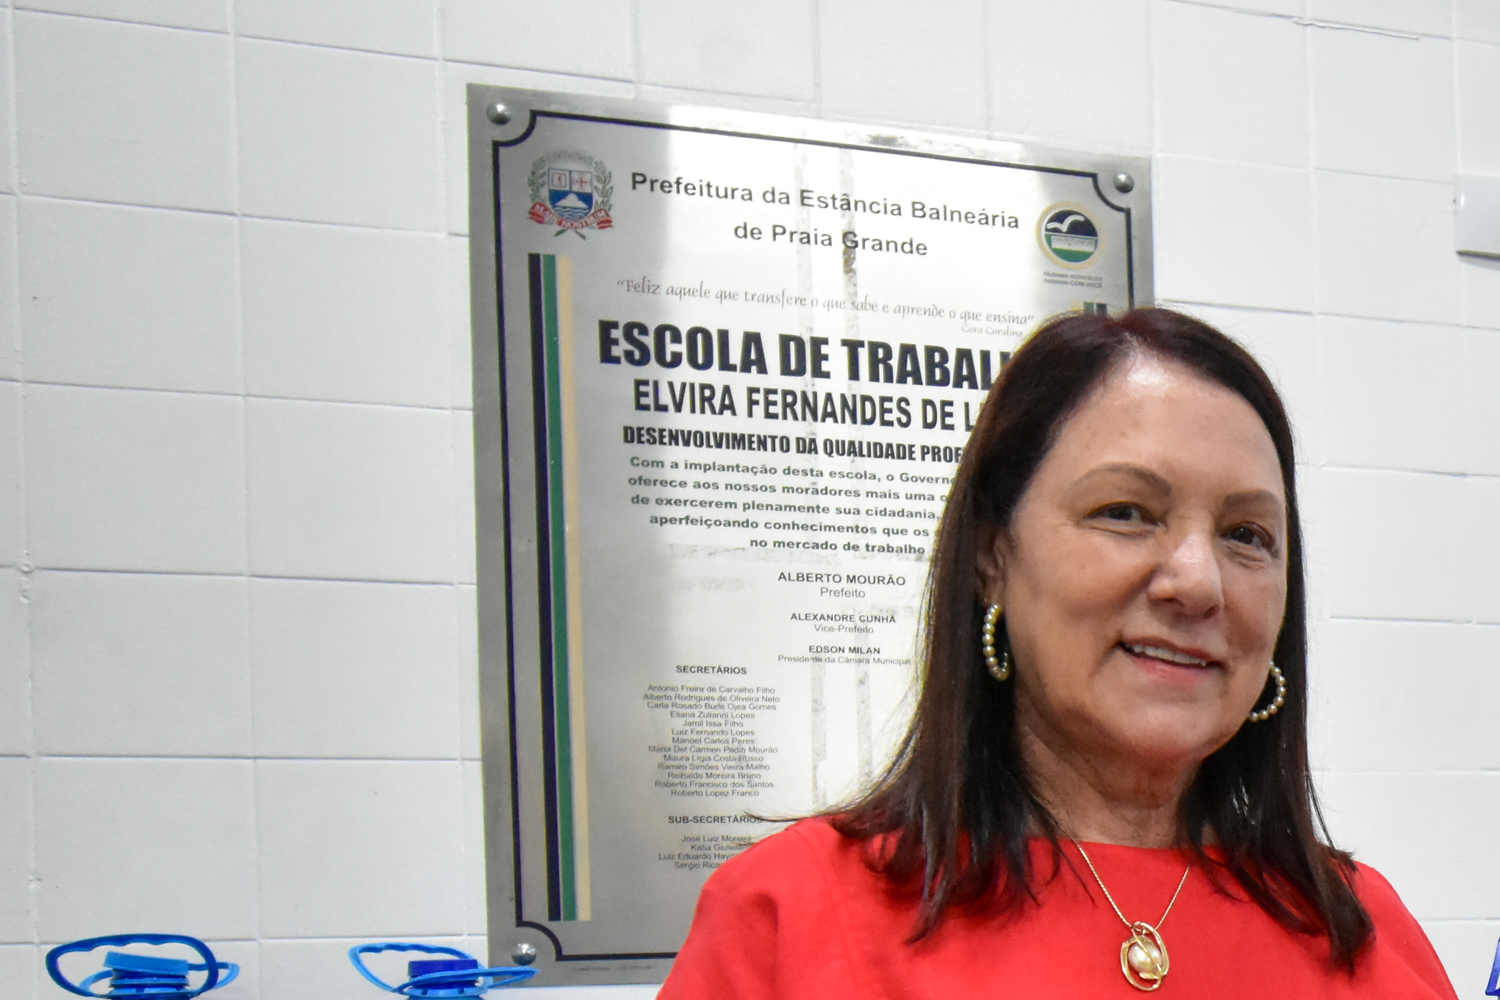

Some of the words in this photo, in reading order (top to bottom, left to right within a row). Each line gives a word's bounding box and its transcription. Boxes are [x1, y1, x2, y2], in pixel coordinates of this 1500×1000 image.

[631, 172, 753, 202] Prefeitura
[762, 187, 790, 205] da
[800, 188, 902, 216] Estância
[911, 201, 1020, 228] Balneária
[734, 222, 762, 240] de
[772, 224, 832, 247] Praia
[842, 231, 928, 256] Grande
[666, 281, 710, 300] aquele
[715, 290, 739, 304] que
[744, 288, 806, 308] transfere
[823, 300, 845, 312] que
[850, 295, 878, 312] sabe
[960, 311, 981, 325] que
[598, 320, 768, 376] ESCOLA
[779, 333, 832, 380] DE
[841, 338, 1010, 391] TRABAL
[633, 380, 737, 416] ELVIRA
[746, 387, 912, 428] FERNANDES
[922, 398, 955, 430] DE
[622, 425, 791, 454] DESENVOLVIMENTO
[796, 437, 819, 455] DA
[823, 439, 916, 461] QUALIDADE
[630, 457, 664, 469] Com
[670, 461, 679, 469] a
[684, 460, 777, 476] implantação
[783, 465, 824, 477] desta
[829, 469, 881, 482] escola,
[886, 473, 894, 481] o
[628, 476, 687, 489] oferece
[693, 481, 720, 490] aos
[724, 482, 776, 493] nossos
[782, 484, 861, 498] moradores
[865, 489, 900, 500] mais
[905, 492, 935, 502] uma
[631, 494, 650, 505] de
[655, 498, 737, 509] exercerem
[742, 500, 829, 514] plenamente
[835, 507, 861, 515] sua
[650, 514, 759, 530] aperfeiçoando
[764, 520, 877, 535] conhecimentos
[882, 527, 909, 538] que
[913, 528, 929, 537] os
[750, 538, 767, 548] no
[772, 540, 837, 552] mercado
[843, 542, 860, 553] de
[865, 543, 925, 555] trabalho
[778, 572, 842, 583] ALBERTO
[847, 574, 905, 586] MOURÃO
[820, 587, 865, 598] Prefeito
[790, 613, 855, 622] ALEXANDRE
[859, 615, 896, 623] CUNHA
[814, 624, 874, 634] Vice-Prefeito
[676, 665, 747, 674] SECRETÁRIOS
[675, 694, 715, 703] Rodrigues
[731, 712, 755, 720] Lopes
[731, 729, 754, 737] Lopes
